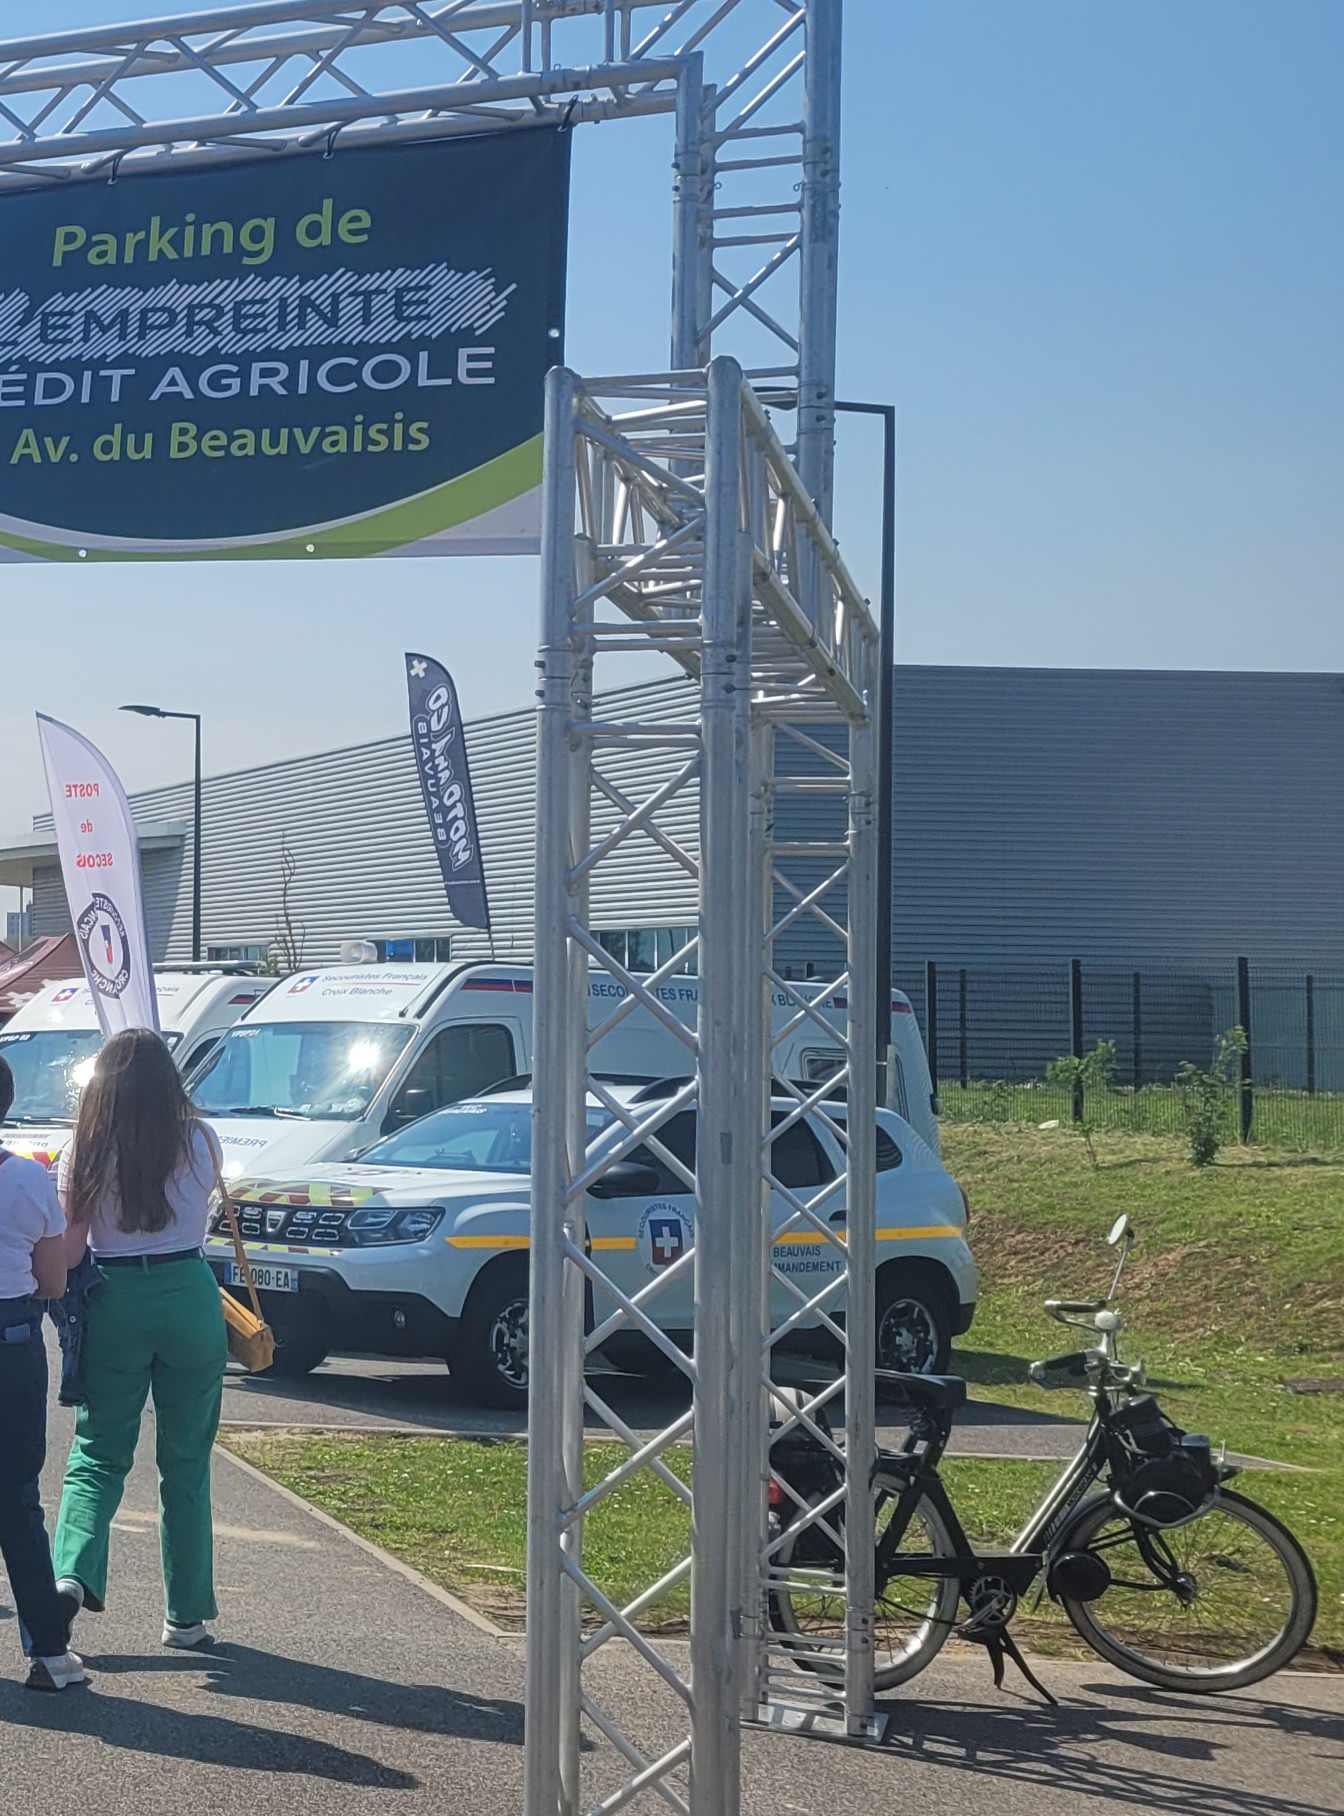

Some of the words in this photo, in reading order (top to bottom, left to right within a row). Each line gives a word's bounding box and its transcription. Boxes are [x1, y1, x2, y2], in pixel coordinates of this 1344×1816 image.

[52, 212, 277, 267] Parking
[295, 198, 373, 248] de
[149, 346, 497, 402] AGRICOLE
[9, 427, 80, 466] Av.
[92, 422, 154, 462] du
[168, 411, 432, 459] Beauvaisis
[383, 972, 430, 982] Français
[321, 988, 347, 996] Croix
[350, 987, 393, 996] Blanche
[773, 1245, 822, 1258] BEAUVAIS
[774, 1260, 842, 1274] MANDEMENT
